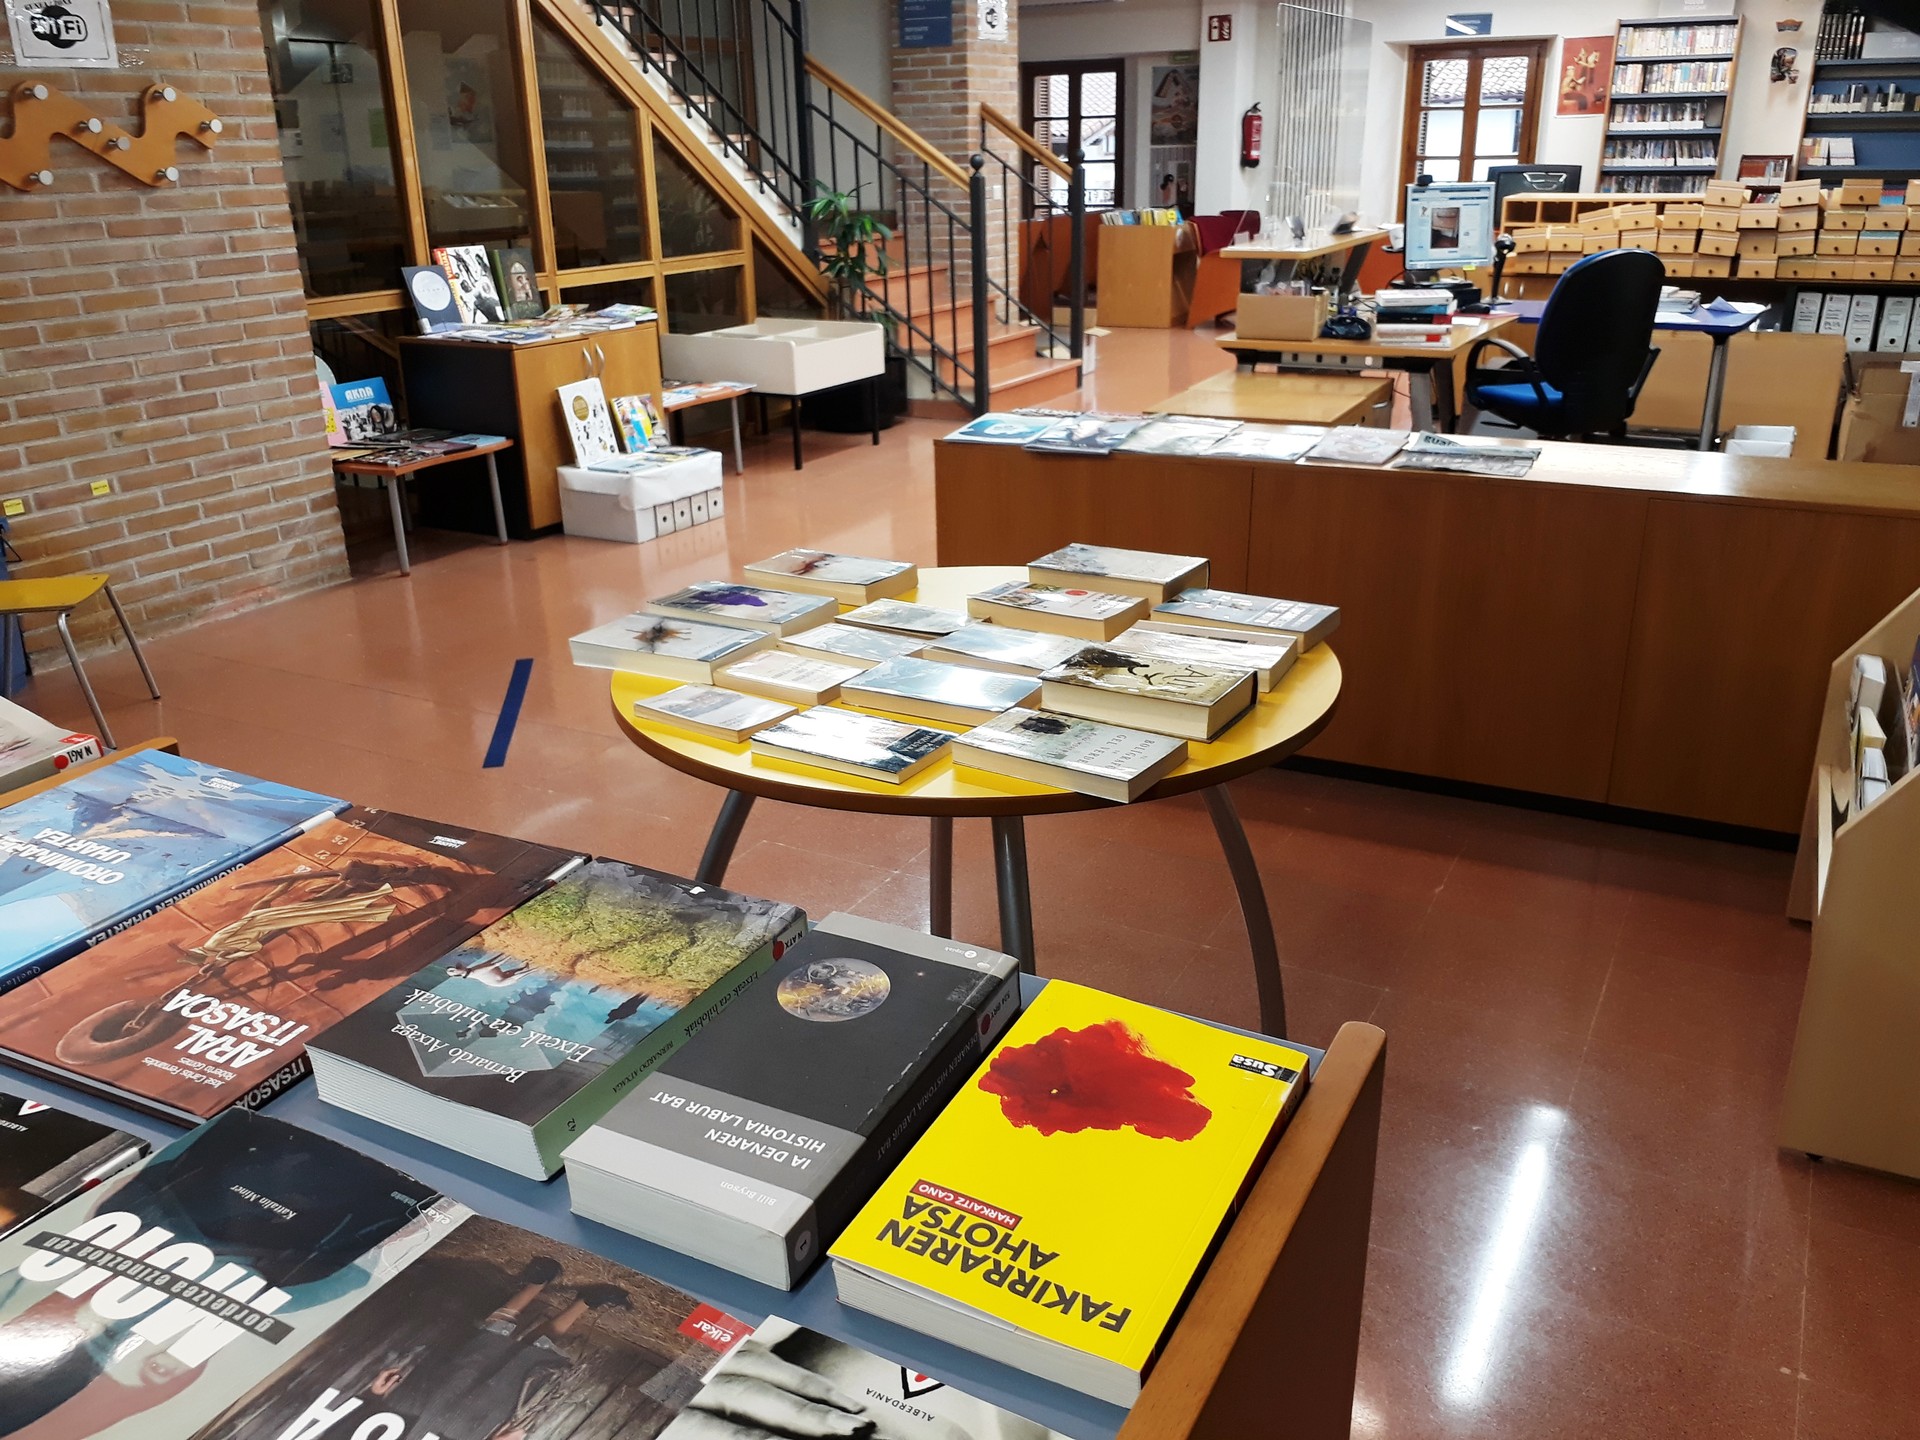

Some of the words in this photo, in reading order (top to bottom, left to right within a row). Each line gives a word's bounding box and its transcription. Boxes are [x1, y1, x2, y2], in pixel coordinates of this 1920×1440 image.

[68, 750, 84, 764] AGI
[86, 746, 93, 756] N
[349, 820, 366, 830] 25
[33, 828, 131, 864] UHARTEA
[332, 835, 348, 845] 26
[315, 850, 331, 859] 27
[162, 988, 309, 1047] ITSASOA
[404, 988, 490, 1029] hilobiak
[684, 1004, 721, 1038] hilobiak
[391, 1023, 449, 1053] Atxaga
[488, 1018, 523, 1036] eta
[174, 1023, 275, 1068] ARAL
[520, 1030, 598, 1063] Etxeak
[639, 1040, 674, 1074] BERNARDO
[181, 1068, 207, 1083] Carlos
[204, 1064, 237, 1081] Roberto
[449, 1048, 527, 1084] Bernardo
[1232, 1055, 1278, 1077] Susa
[650, 1091, 687, 1108] BAT
[685, 1101, 744, 1127] LABUR
[704, 1128, 789, 1163] DENAREN
[745, 1119, 826, 1154] HISTORIA
[791, 1154, 812, 1170] IA
[230, 1184, 261, 1202] Miner
[720, 1180, 757, 1199] Bryson
[757, 1195, 777, 1206] Bill
[918, 1183, 955, 1202] CANO
[257, 1194, 297, 1221] Kattalin
[421, 1207, 451, 1225] elkar
[954, 1197, 1016, 1226] HARKAITZ
[43, 1235, 73, 1253] zen
[902, 1195, 1060, 1271] AHOTSA
[76, 1245, 165, 1287] ezinezkoa
[876, 1218, 1132, 1333] FAKIRRAREN
[170, 1279, 274, 1334] gordetzea
[693, 1321, 732, 1343] elkar
[865, 1387, 935, 1422] ALBERDANIA
